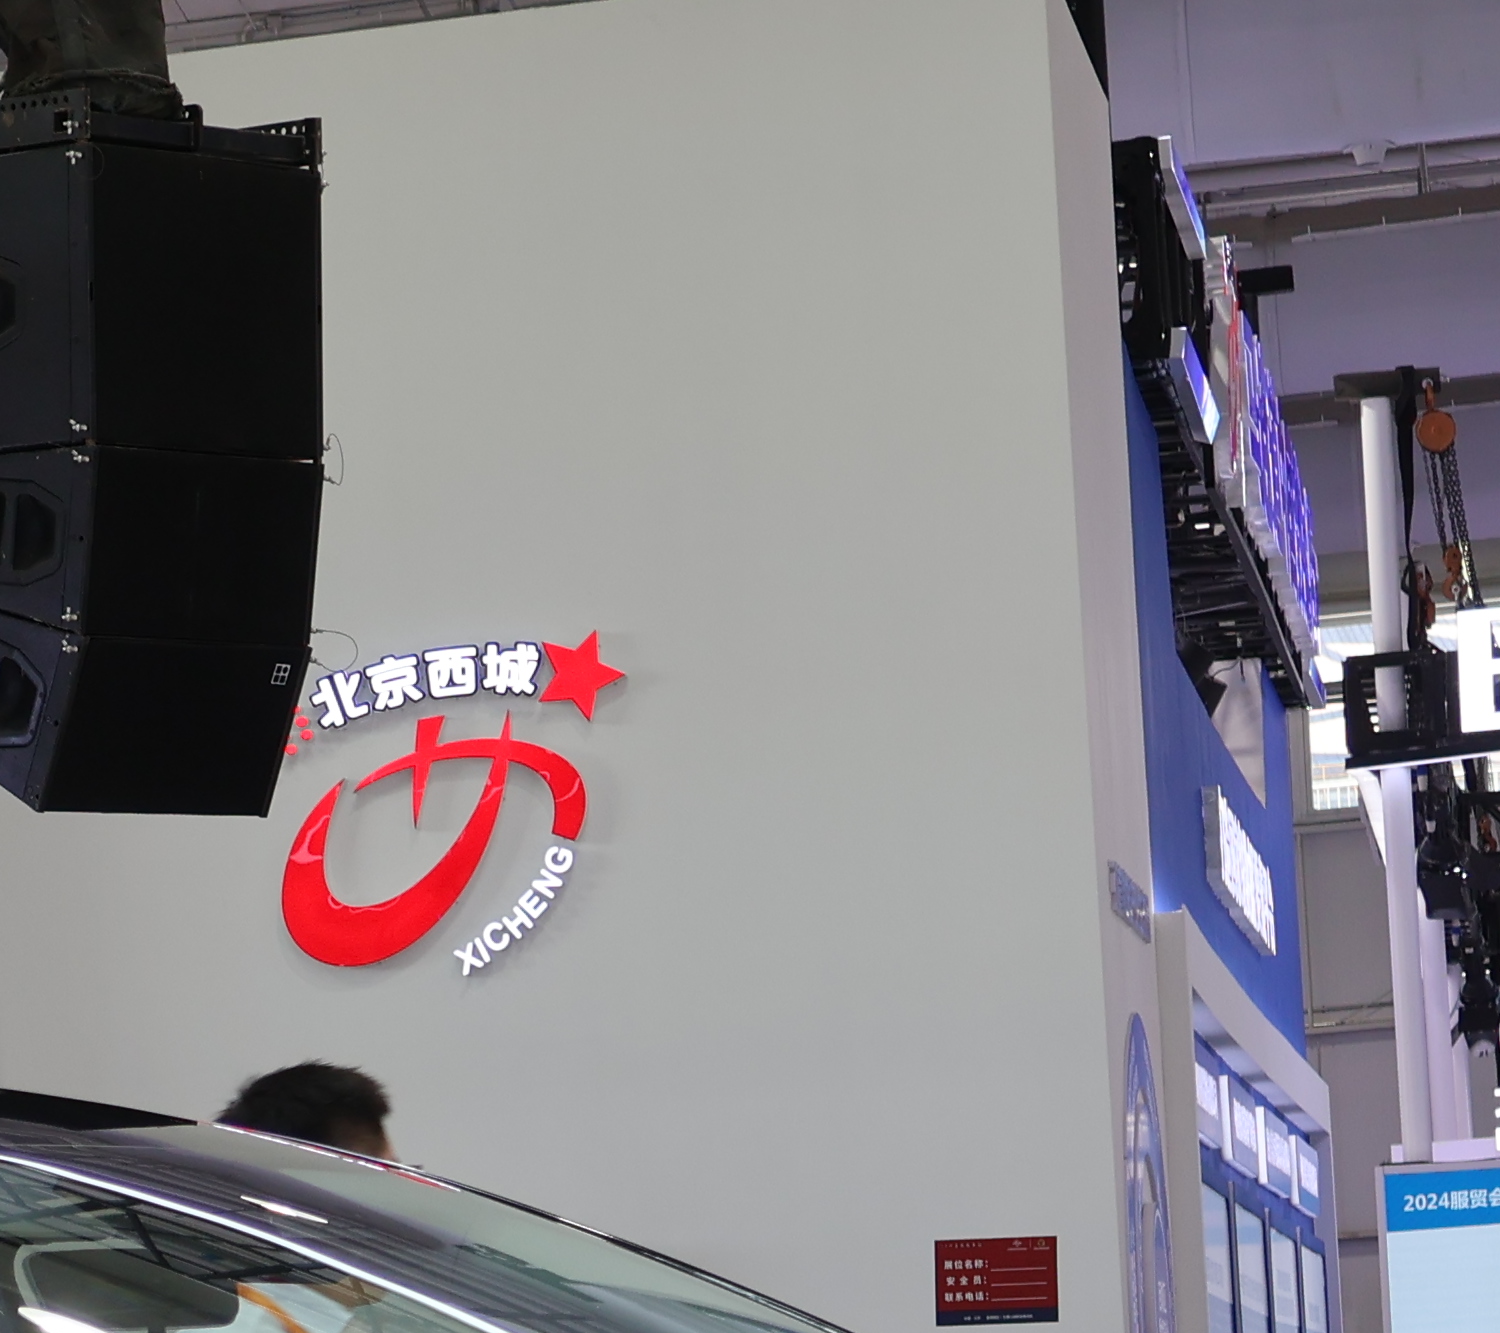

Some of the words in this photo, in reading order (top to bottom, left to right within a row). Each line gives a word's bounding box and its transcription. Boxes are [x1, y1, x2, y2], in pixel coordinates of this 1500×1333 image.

[310, 642, 543, 730] 北京西城
[453, 845, 574, 977] XICHENG
